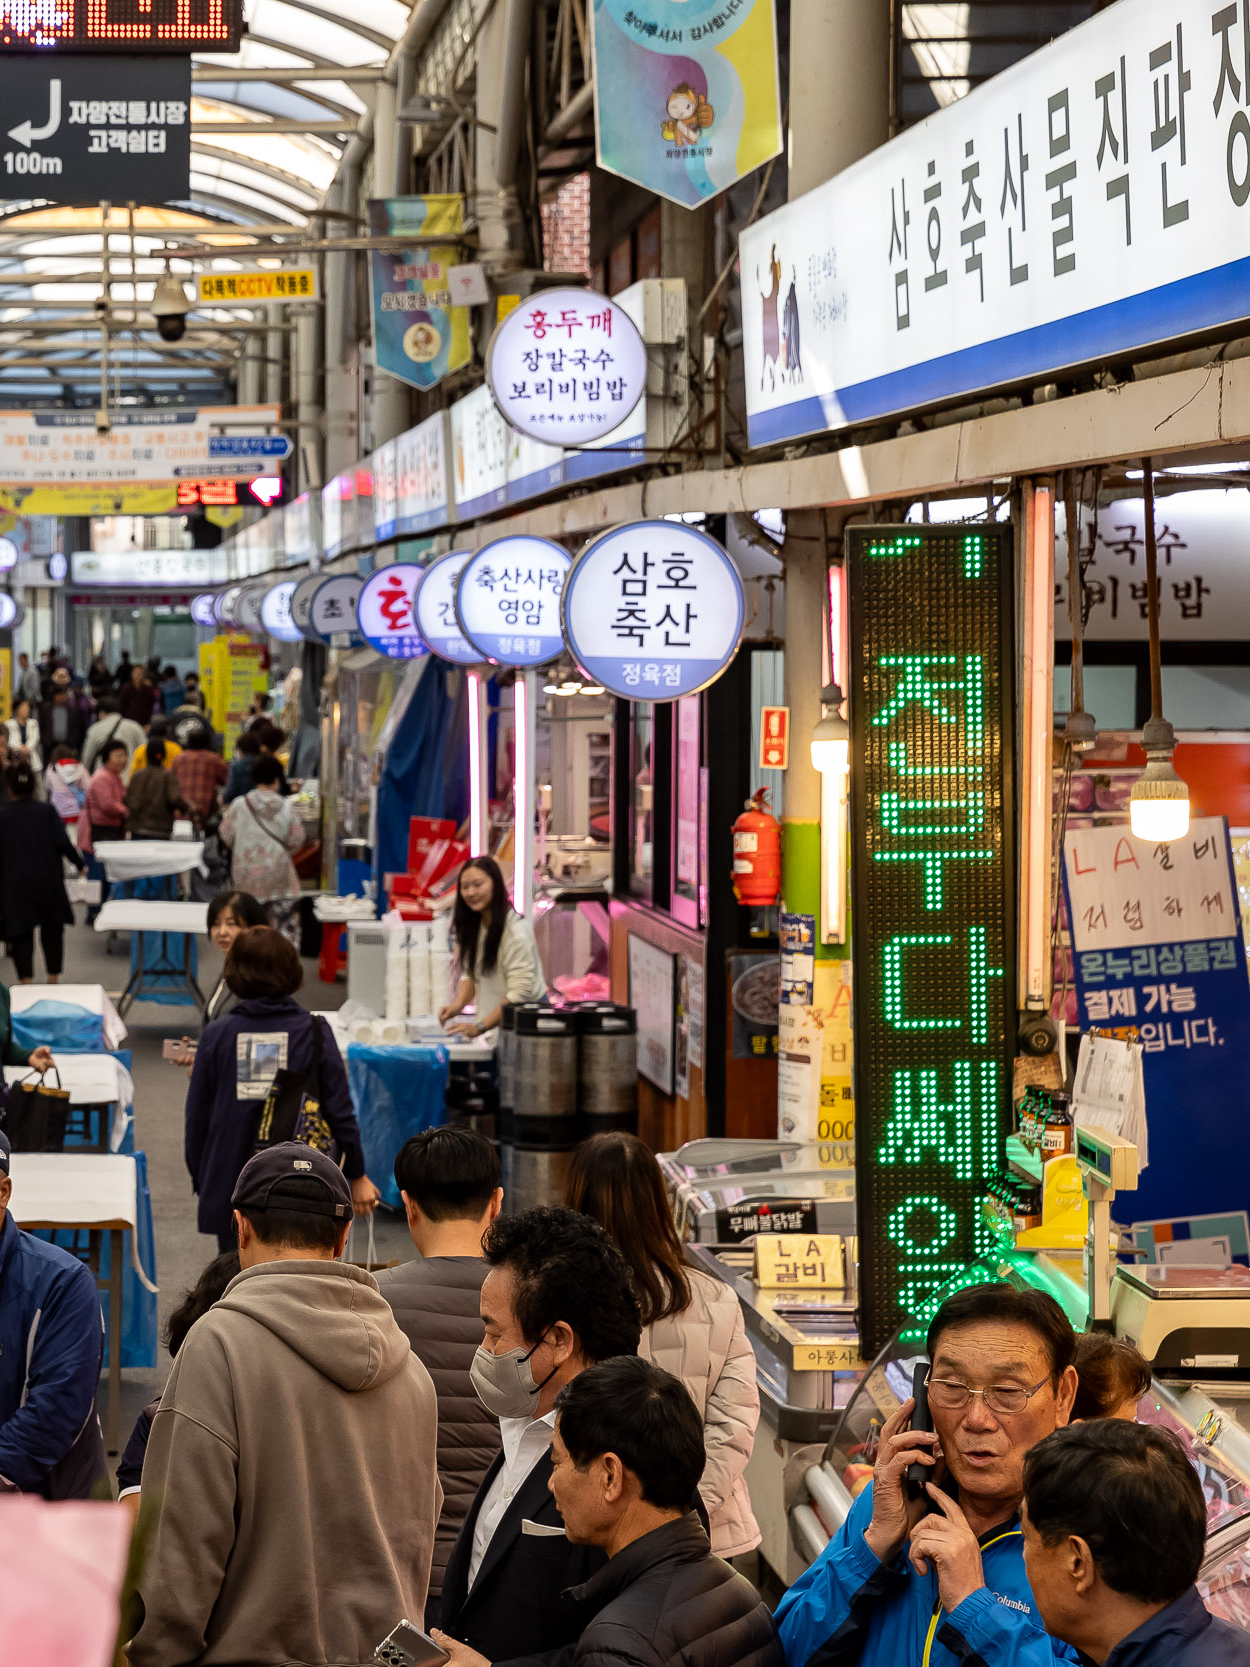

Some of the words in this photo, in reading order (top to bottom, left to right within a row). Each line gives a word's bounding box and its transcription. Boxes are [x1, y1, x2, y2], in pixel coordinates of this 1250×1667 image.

[68, 101, 188, 125] 자양전통시장
[88, 130, 166, 153] 고객쉼터
[4, 153, 62, 175] 100m
[888, 0, 1250, 331] 삼호축산물직판장
[524, 308, 613, 339] 홍두깨
[521, 348, 614, 372] 장칼국수
[508, 377, 628, 402] 보리비빔밥
[612, 551, 698, 599] 삼호
[498, 599, 545, 625] 영암
[610, 601, 698, 649] 축산
[499, 639, 542, 657] 정육점
[621, 663, 682, 687] 정육점
[1080, 940, 1238, 983] 온누리상품권
[1083, 987, 1138, 1021] 결제
[1142, 982, 1197, 1014] 가능
[774, 1262, 826, 1283] 갈비
